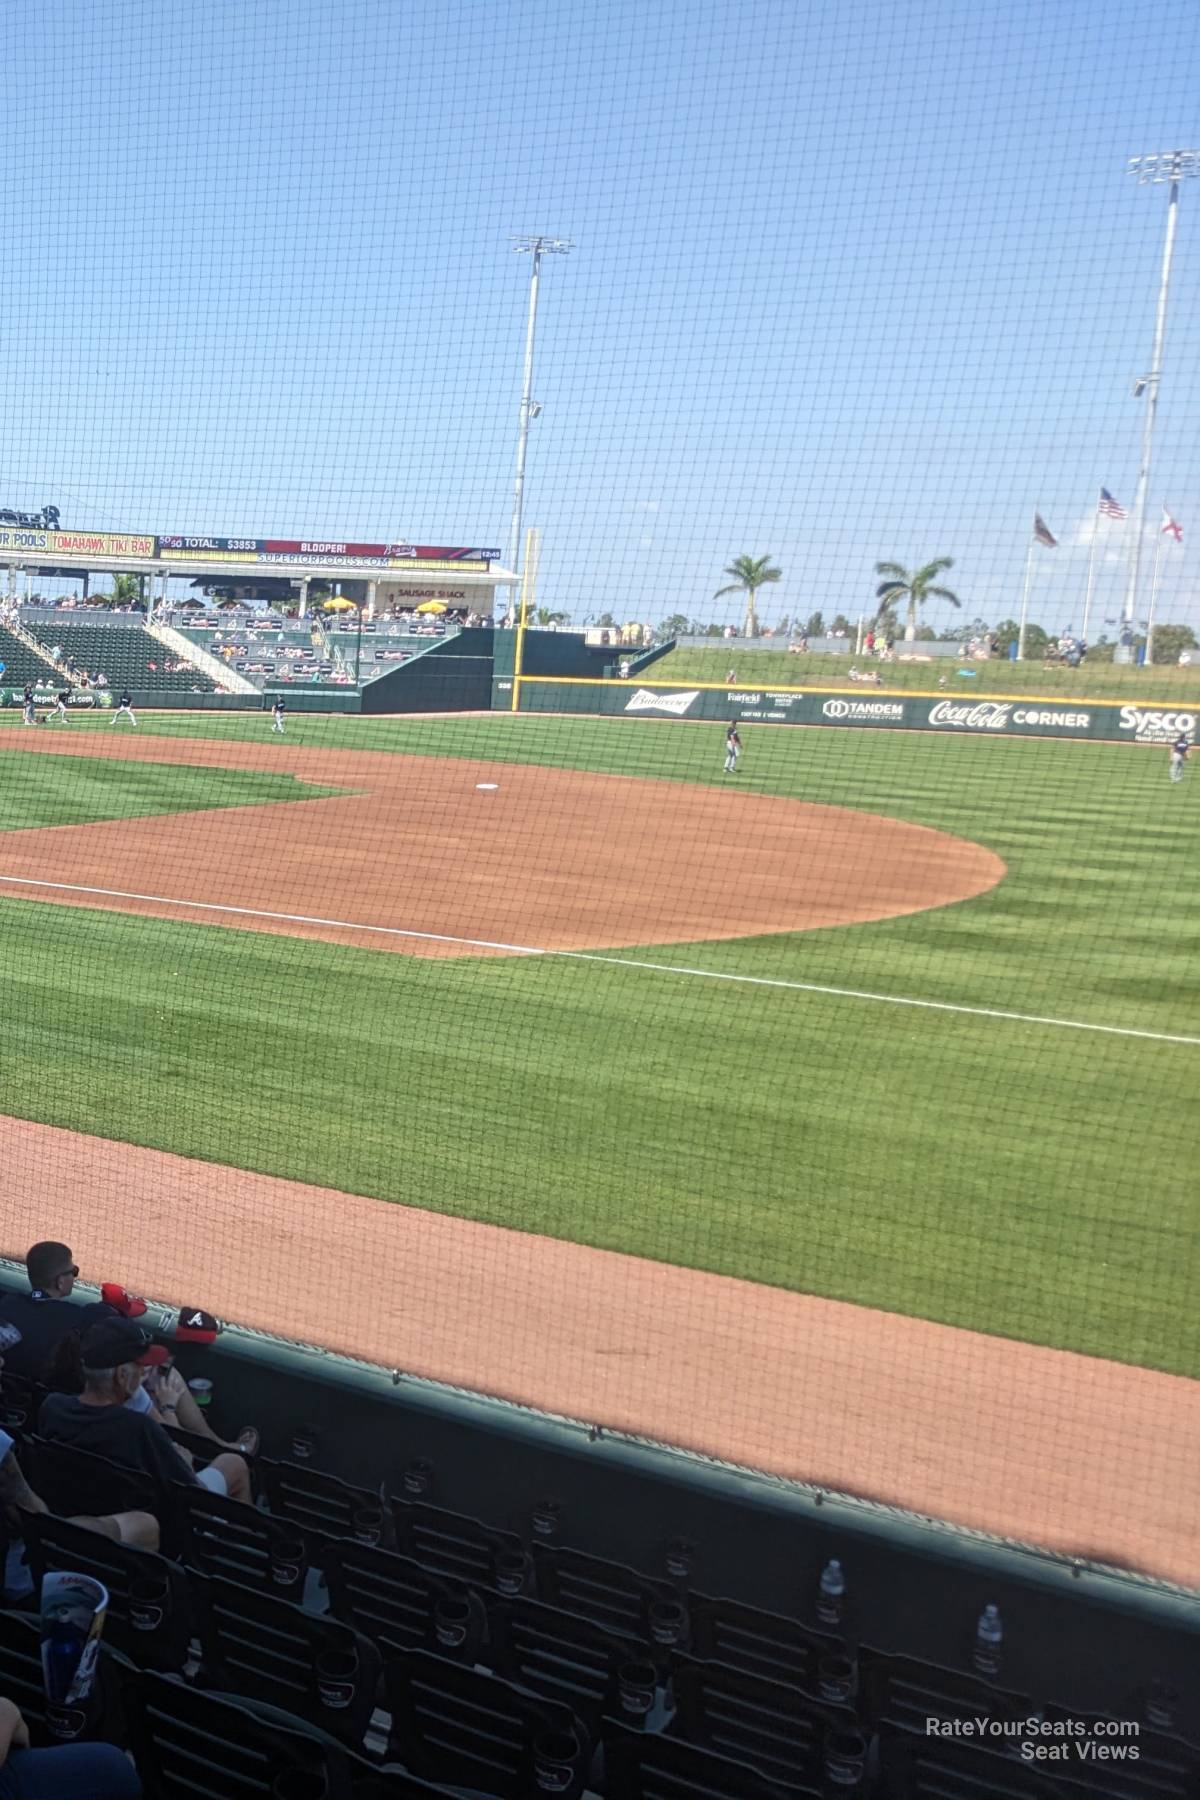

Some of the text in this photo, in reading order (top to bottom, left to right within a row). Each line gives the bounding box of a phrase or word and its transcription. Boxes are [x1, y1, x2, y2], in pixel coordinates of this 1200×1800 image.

[14, 533, 46, 547] POOLS
[52, 535, 105, 551] TOMAHAWK
[110, 539, 127, 552] TIKI
[132, 541, 151, 553] BAR
[185, 538, 218, 549] TOTAL:
[301, 543, 347, 553] BLOOPER!
[258, 553, 390, 568] SUPERIORPOOLS.COM
[399, 589, 436, 597] SAUSAGE
[849, 703, 904, 714] TANDEM
[1013, 711, 1090, 727] CORNER
[1119, 705, 1196, 733] Sysco
